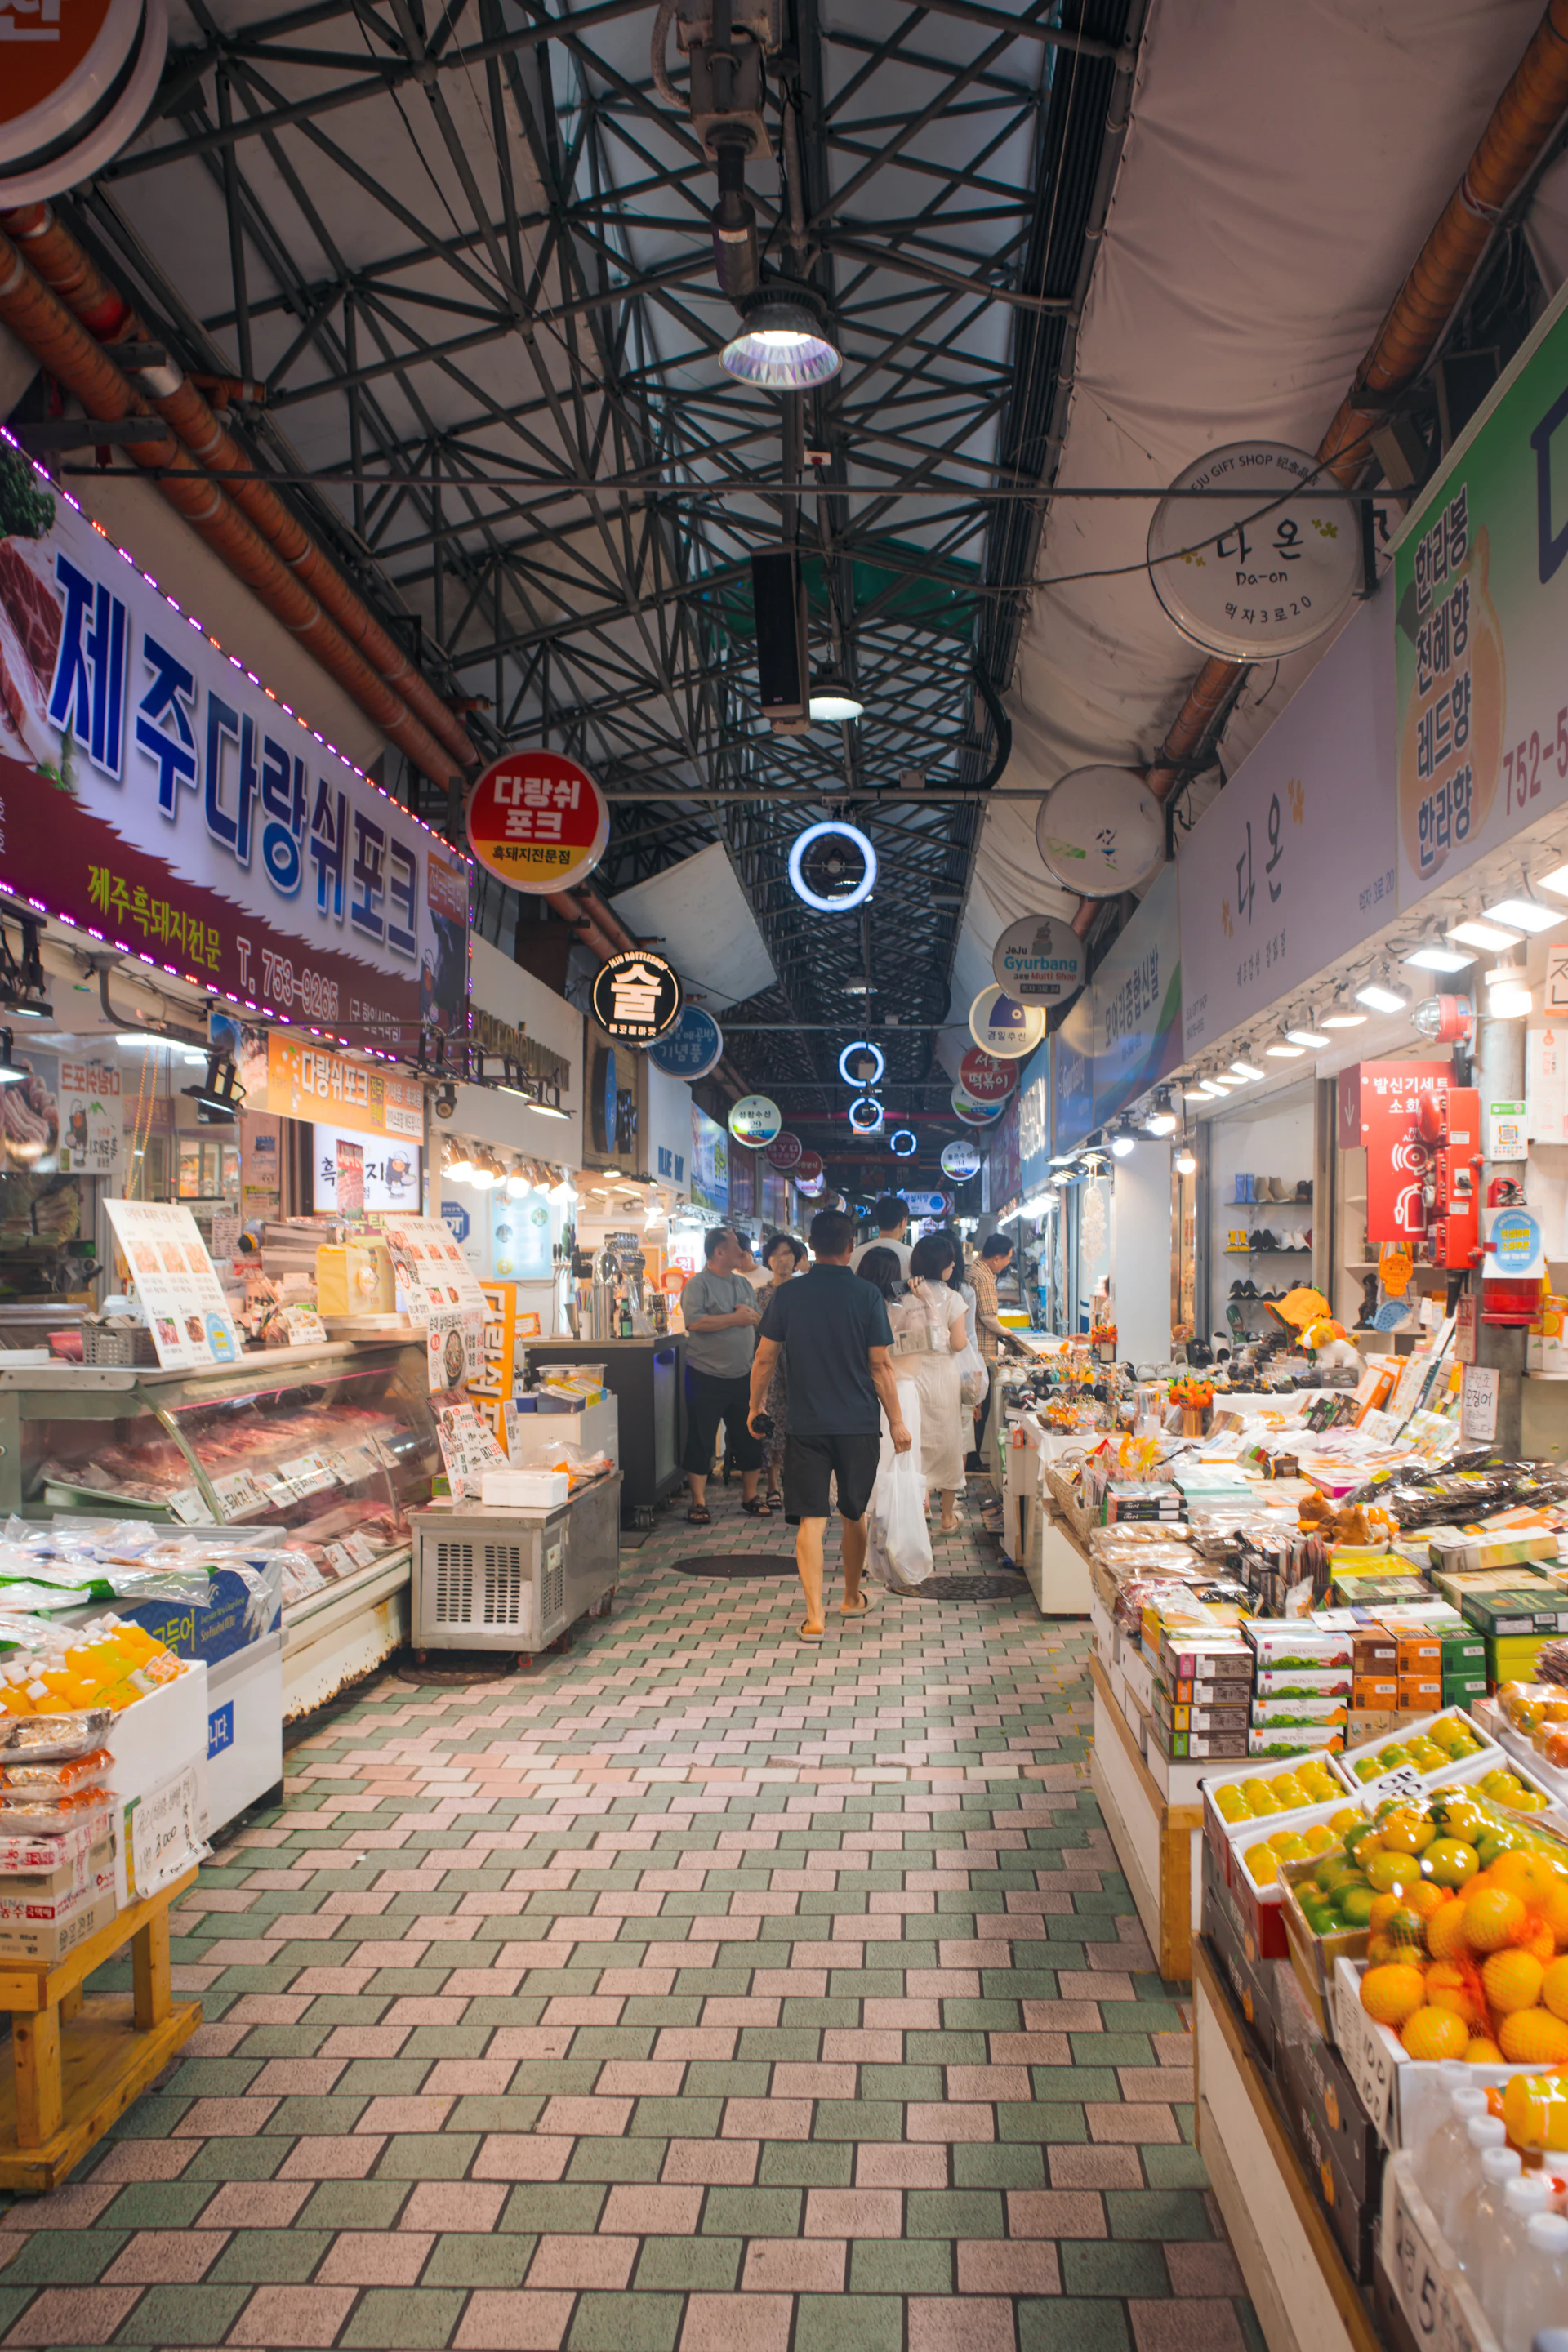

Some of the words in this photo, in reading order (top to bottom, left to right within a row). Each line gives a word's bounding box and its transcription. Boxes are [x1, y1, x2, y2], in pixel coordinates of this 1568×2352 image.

[1211, 457, 1235, 478] GIFT
[1239, 453, 1273, 468] SHOP
[1414, 483, 1469, 613] 한라봉
[1236, 571, 1289, 586] Da-on
[1416, 576, 1471, 697] 천혜향
[1417, 670, 1472, 780] 레드향
[493, 775, 581, 810] 다랑쉬
[505, 808, 564, 840] 포크
[492, 844, 571, 866] 흑돼지전문점
[1236, 791, 1284, 926] 다온
[1386, 868, 1395, 895] 20
[608, 954, 625, 969] JEJU
[1004, 956, 1078, 973] Gyurbang
[236, 935, 256, 995] T.
[261, 947, 340, 1021] 753-9265
[1031, 972, 1054, 980] Multi
[1055, 972, 1077, 982] Shop
[610, 963, 662, 1022] 술
[659, 1042, 702, 1062] 기념품
[301, 1049, 368, 1107] 다랑쉬포크
[969, 1073, 1009, 1091] 떡볶이
[1374, 1076, 1449, 1094] 발신기세트
[321, 1156, 385, 1187] 흑지
[1465, 1388, 1493, 1408] 오징어
